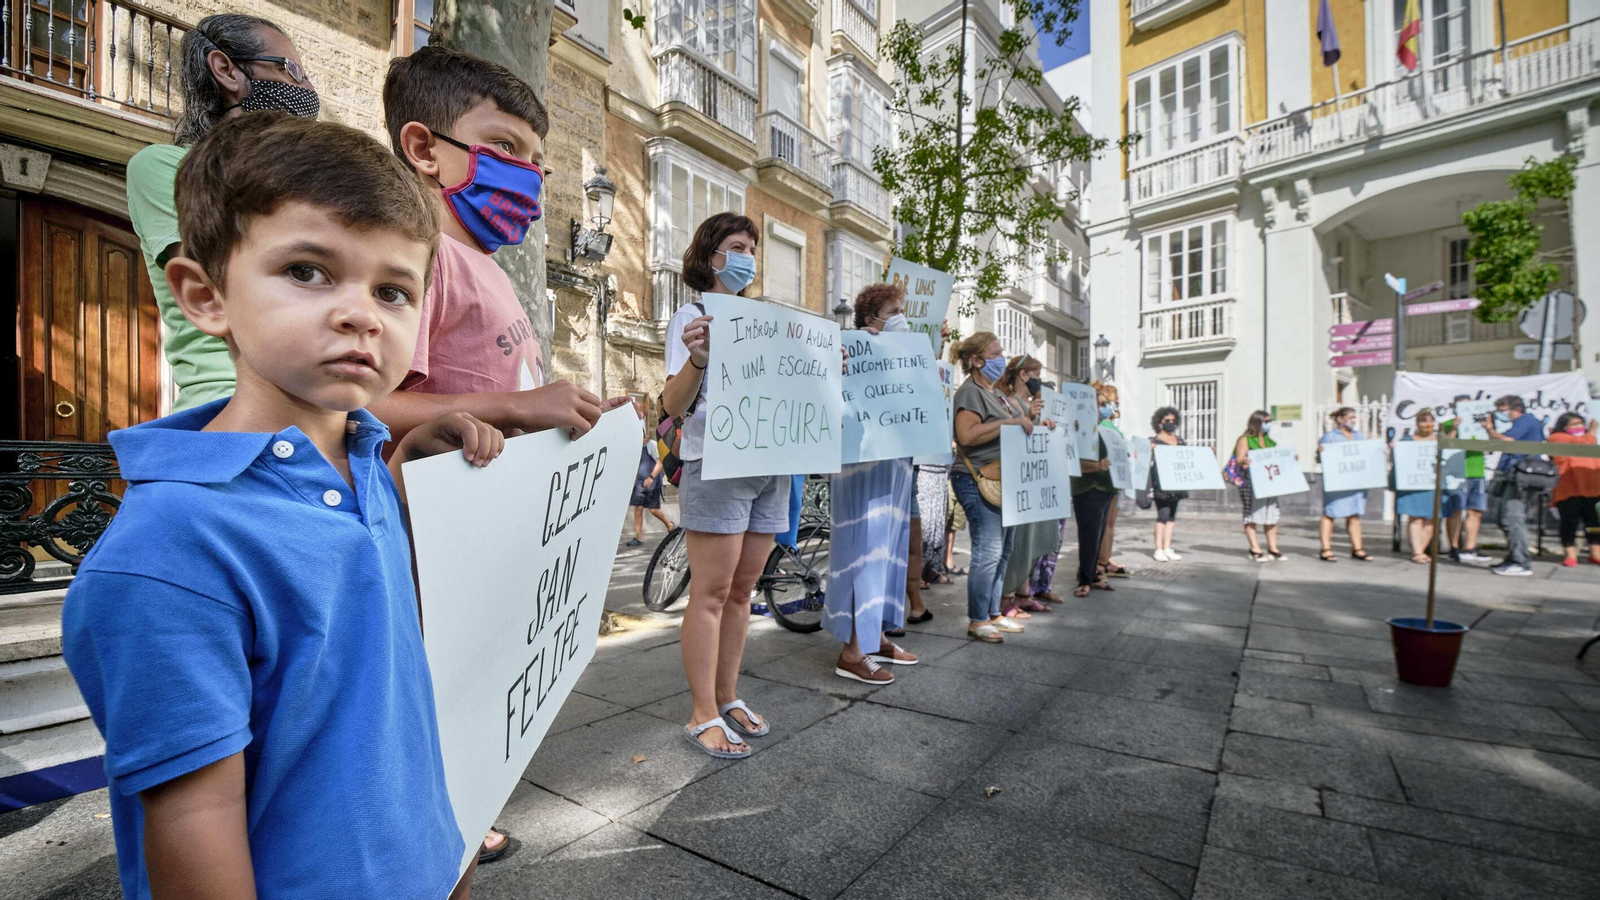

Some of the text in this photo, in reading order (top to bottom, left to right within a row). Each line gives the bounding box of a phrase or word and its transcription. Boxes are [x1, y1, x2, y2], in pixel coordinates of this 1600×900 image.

[915, 277, 936, 297] UNAS
[730, 316, 833, 351] IMBRODA NO AYUDA
[842, 340, 873, 358] ODA
[721, 354, 827, 391] A UNA ESCUELA
[845, 354, 930, 377] INCOMPETENTE
[864, 383, 915, 399] QUEDES
[733, 395, 832, 451] SEGURA
[856, 411, 871, 422] LA
[878, 407, 929, 427] GENTE
[1020, 459, 1049, 484] CAMPO
[1016, 486, 1059, 513] DEL SUR
[526, 537, 582, 646] SAN
[503, 593, 589, 764] FELIPE
